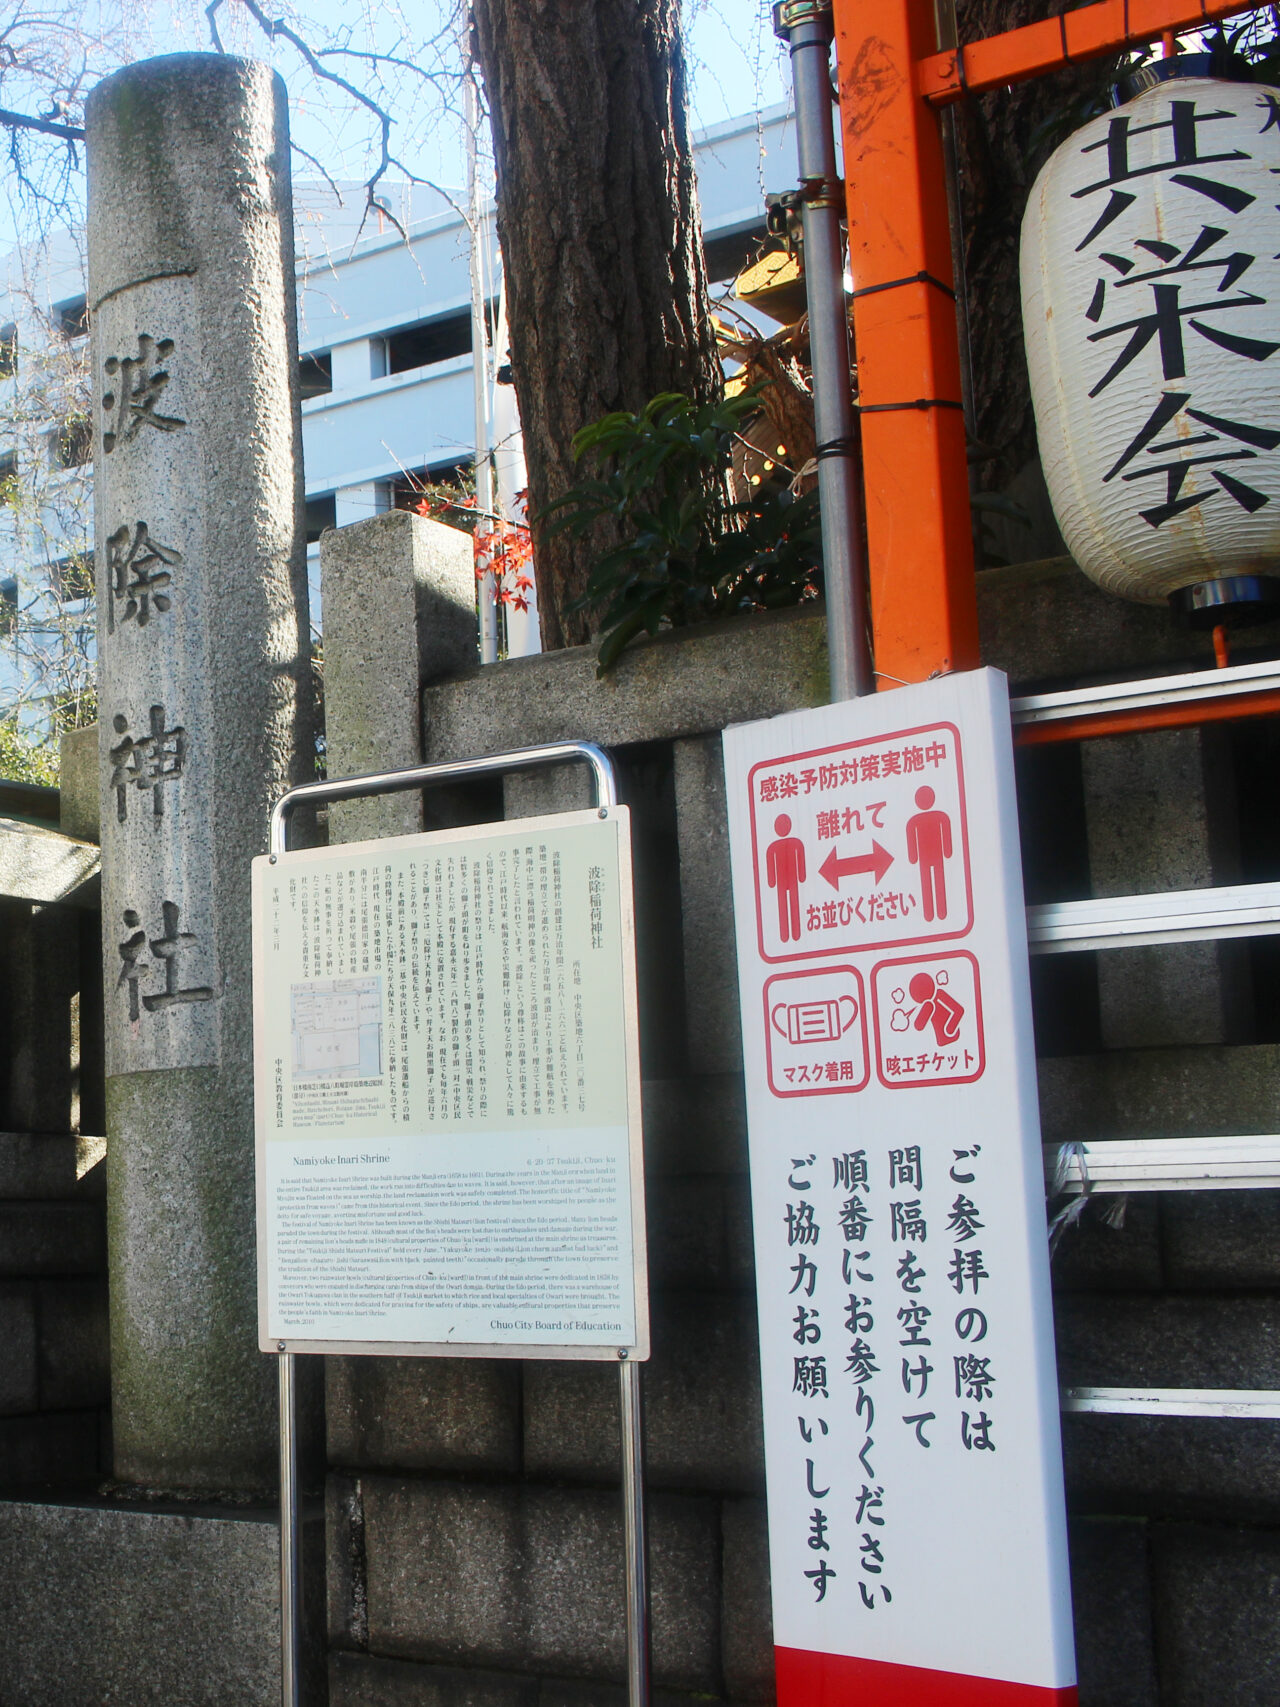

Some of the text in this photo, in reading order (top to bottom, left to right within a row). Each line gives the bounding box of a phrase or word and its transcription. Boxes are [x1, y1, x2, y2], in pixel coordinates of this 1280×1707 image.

[1070, 100, 1280, 529] 共栄会
[103, 333, 215, 1022] 波除神社
[760, 741, 947, 803] 感染予防対策実施中
[816, 801, 887, 841] 離れて
[588, 865, 603, 950] 波除稲荷神社
[806, 890, 917, 932] お並びください
[783, 1060, 854, 1084] マスク着用
[886, 1049, 974, 1076] 咳エチケット
[293, 1153, 390, 1167] Namiyoke Inari Shrine
[490, 1320, 622, 1331] Chuo City Board of Education
[888, 1143, 937, 1449] 間隔を空けて
[943, 1143, 997, 1453] ご参拝の際は
[784, 1153, 837, 1603] ご協力お願いします
[832, 1149, 893, 1610] 順番にお参りください
